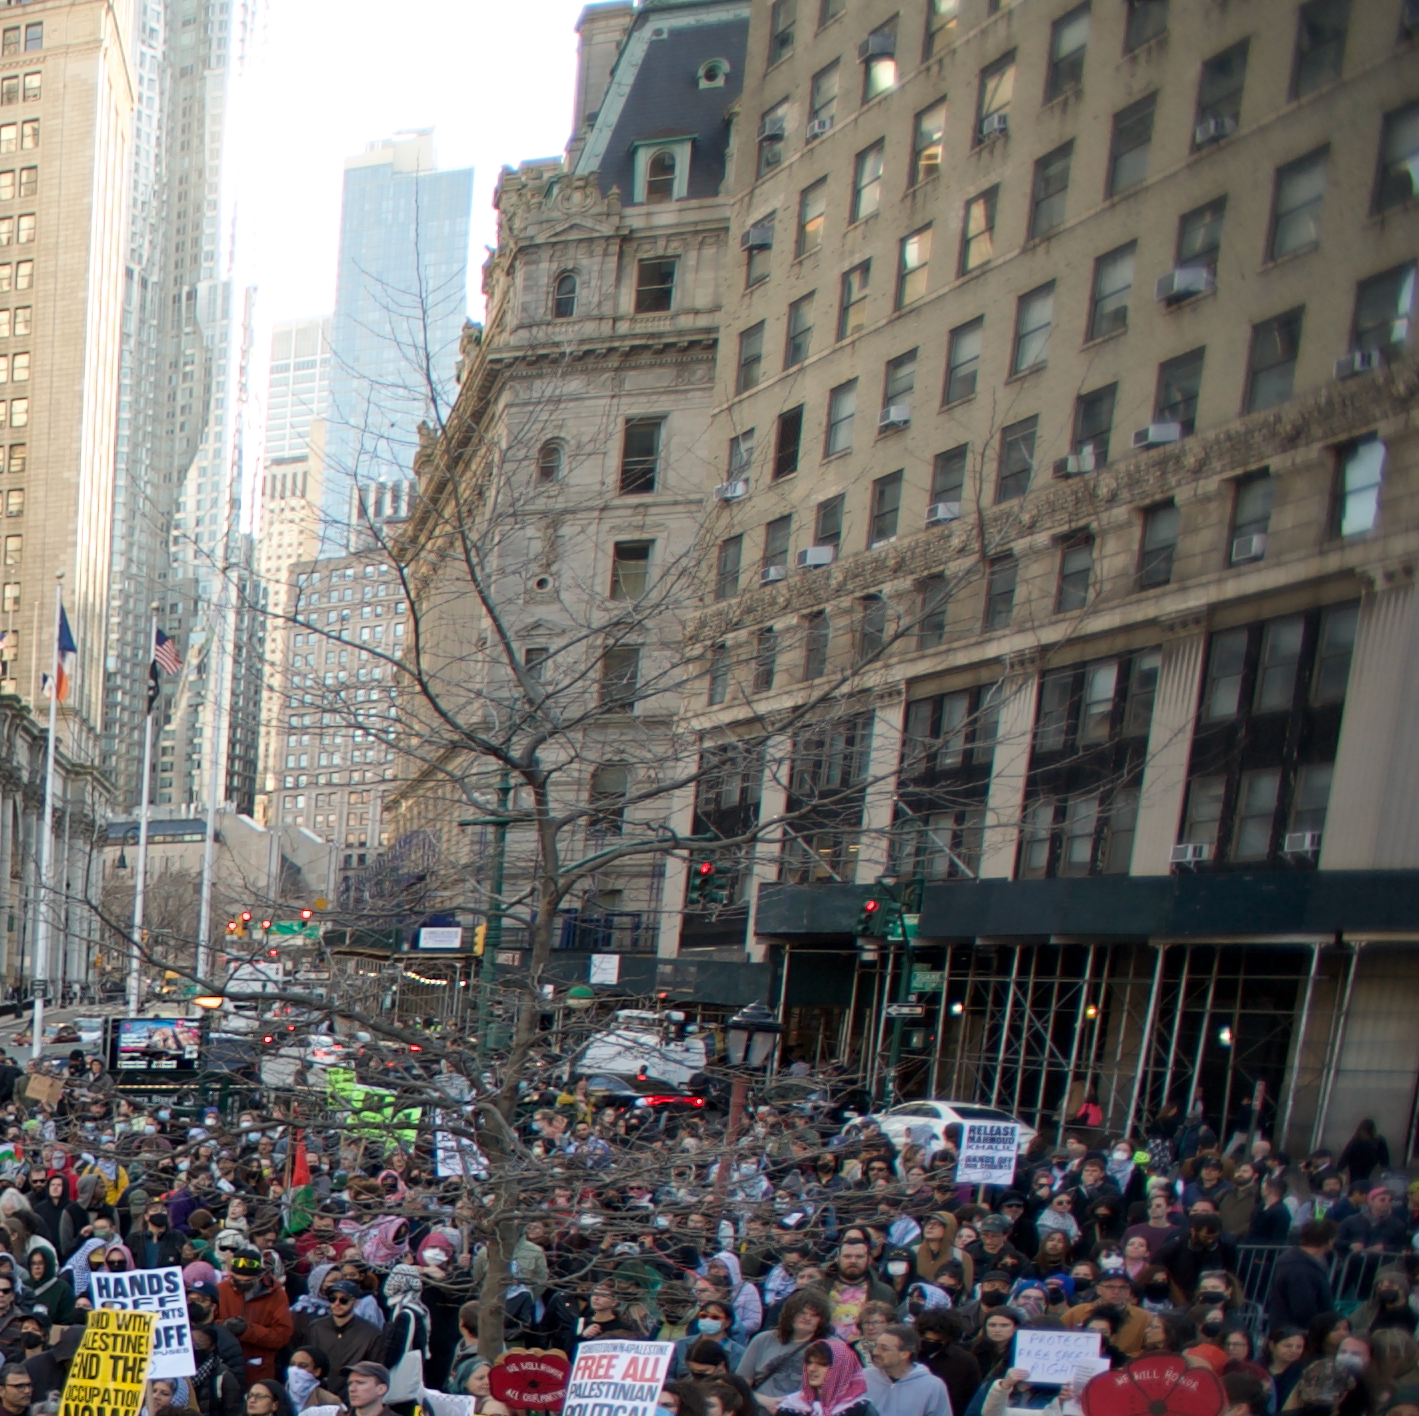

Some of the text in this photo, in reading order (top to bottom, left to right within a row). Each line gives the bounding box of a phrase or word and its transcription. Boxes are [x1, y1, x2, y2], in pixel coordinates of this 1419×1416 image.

[969, 1125, 1017, 1136] RELEASE
[96, 1271, 180, 1299] HANDS
[1029, 1333, 1091, 1348] PROTECT
[1018, 1349, 1050, 1361] FREE
[110, 1356, 148, 1384] THE
[573, 1355, 619, 1381] FREE
[621, 1357, 662, 1382] ALL
[1115, 1370, 1160, 1386] WE WILL
[569, 1382, 658, 1402] PALESTINIAN
